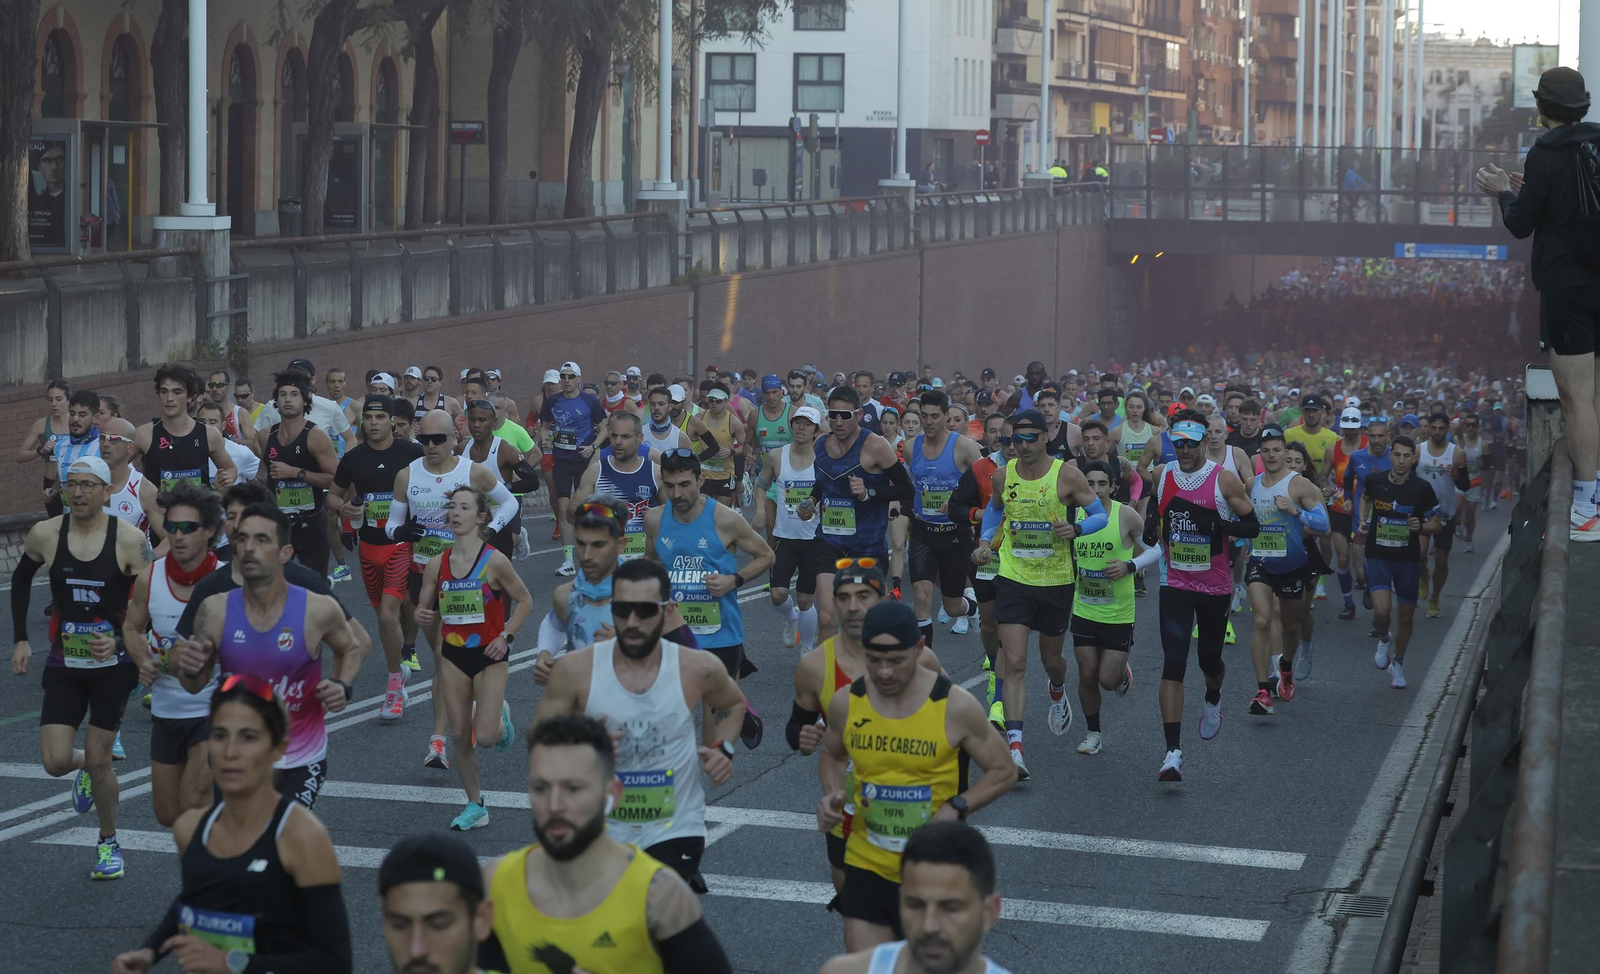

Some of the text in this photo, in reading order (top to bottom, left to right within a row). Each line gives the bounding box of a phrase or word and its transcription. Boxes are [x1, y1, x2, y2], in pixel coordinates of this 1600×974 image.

[829, 518, 846, 526] MIKA
[428, 530, 452, 538] ZURICH
[1077, 542, 1088, 550] UN
[1173, 552, 1207, 562] TRUFERO
[673, 556, 704, 570] 42K
[451, 581, 476, 589] ZURICH
[686, 593, 712, 601] ZURICH
[1084, 588, 1106, 597] FELIPE
[445, 602, 477, 613] JEMIMA
[77, 624, 107, 632] ZURICH
[64, 647, 91, 657] BELEN
[850, 733, 937, 757] VILLA DE CABEZON
[624, 775, 666, 785] ZURICH
[625, 794, 647, 803] 2515
[881, 788, 922, 799] ZURICH
[612, 807, 662, 820] TOMMY
[884, 807, 904, 818] 1976
[197, 913, 243, 932] ZURICH
